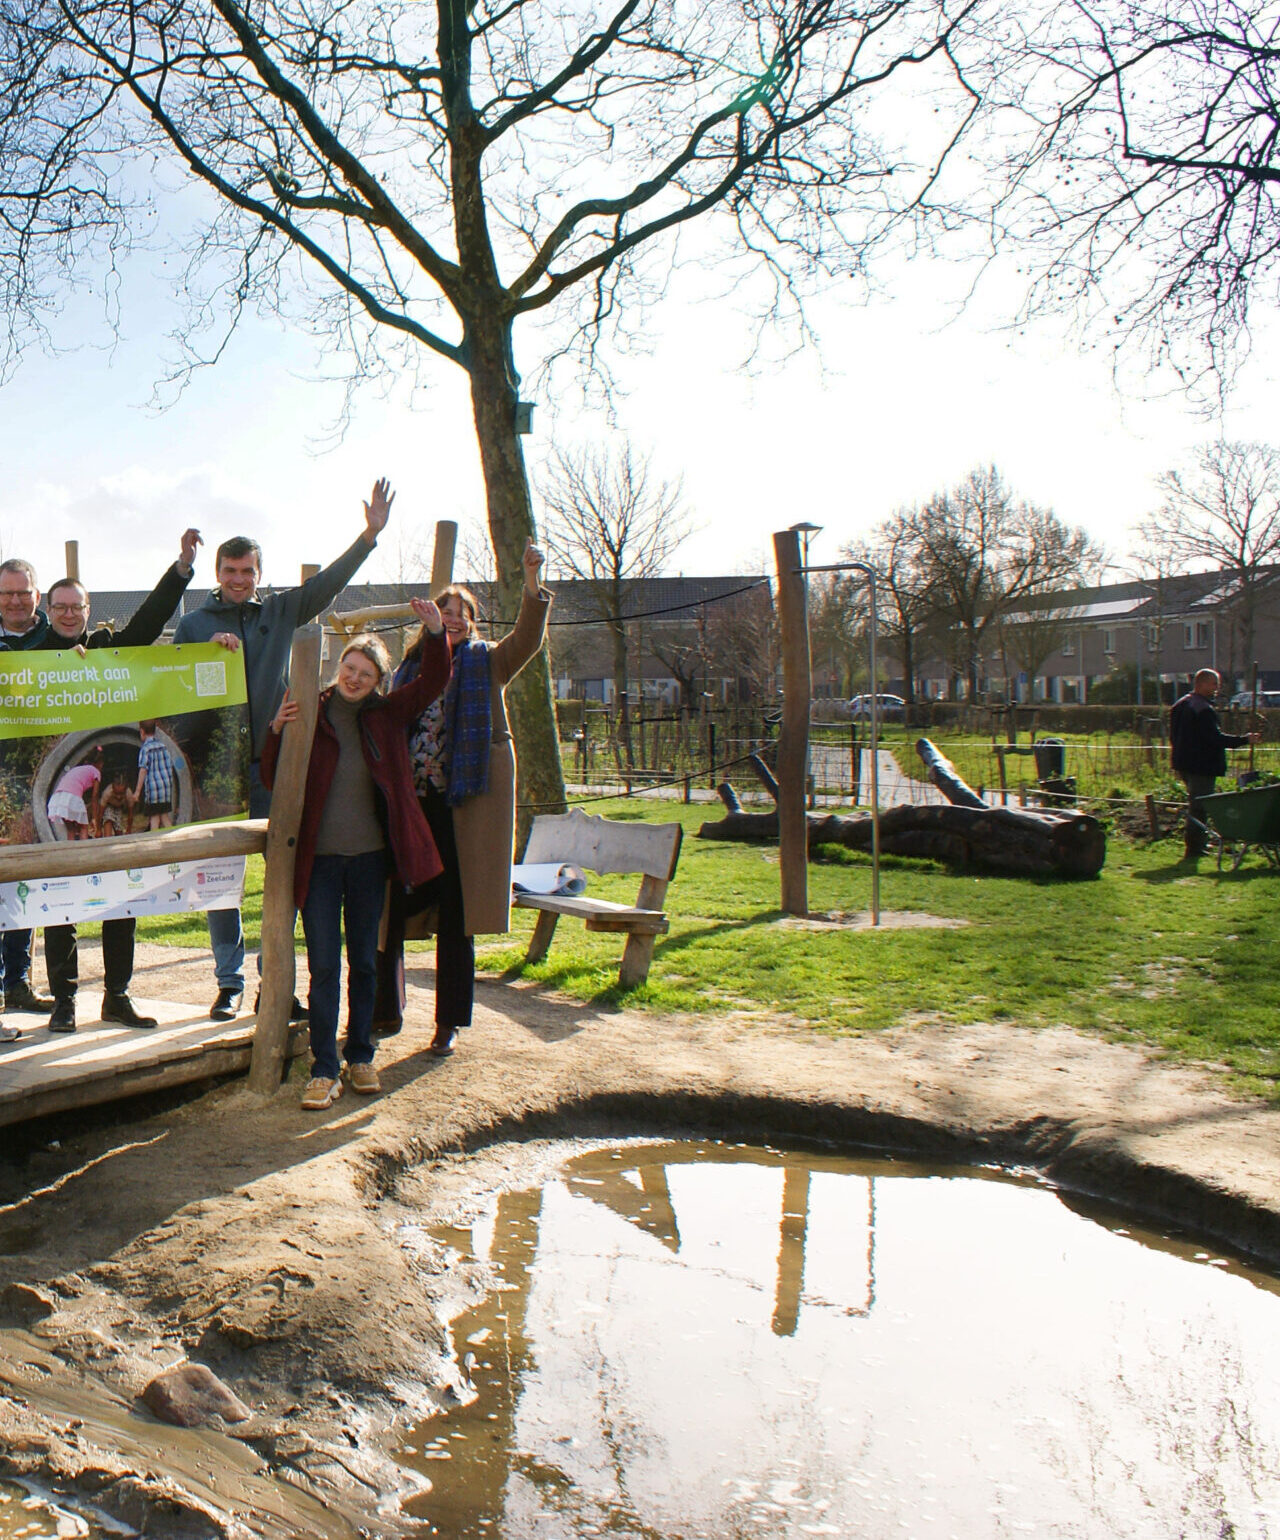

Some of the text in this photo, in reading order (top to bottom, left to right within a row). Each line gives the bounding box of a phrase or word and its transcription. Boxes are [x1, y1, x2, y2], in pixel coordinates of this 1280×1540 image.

[37, 666, 100, 690] gewerkt
[103, 667, 131, 681] aan
[46, 686, 139, 708] schoolplein!
[206, 873, 235, 883] Zeeland
